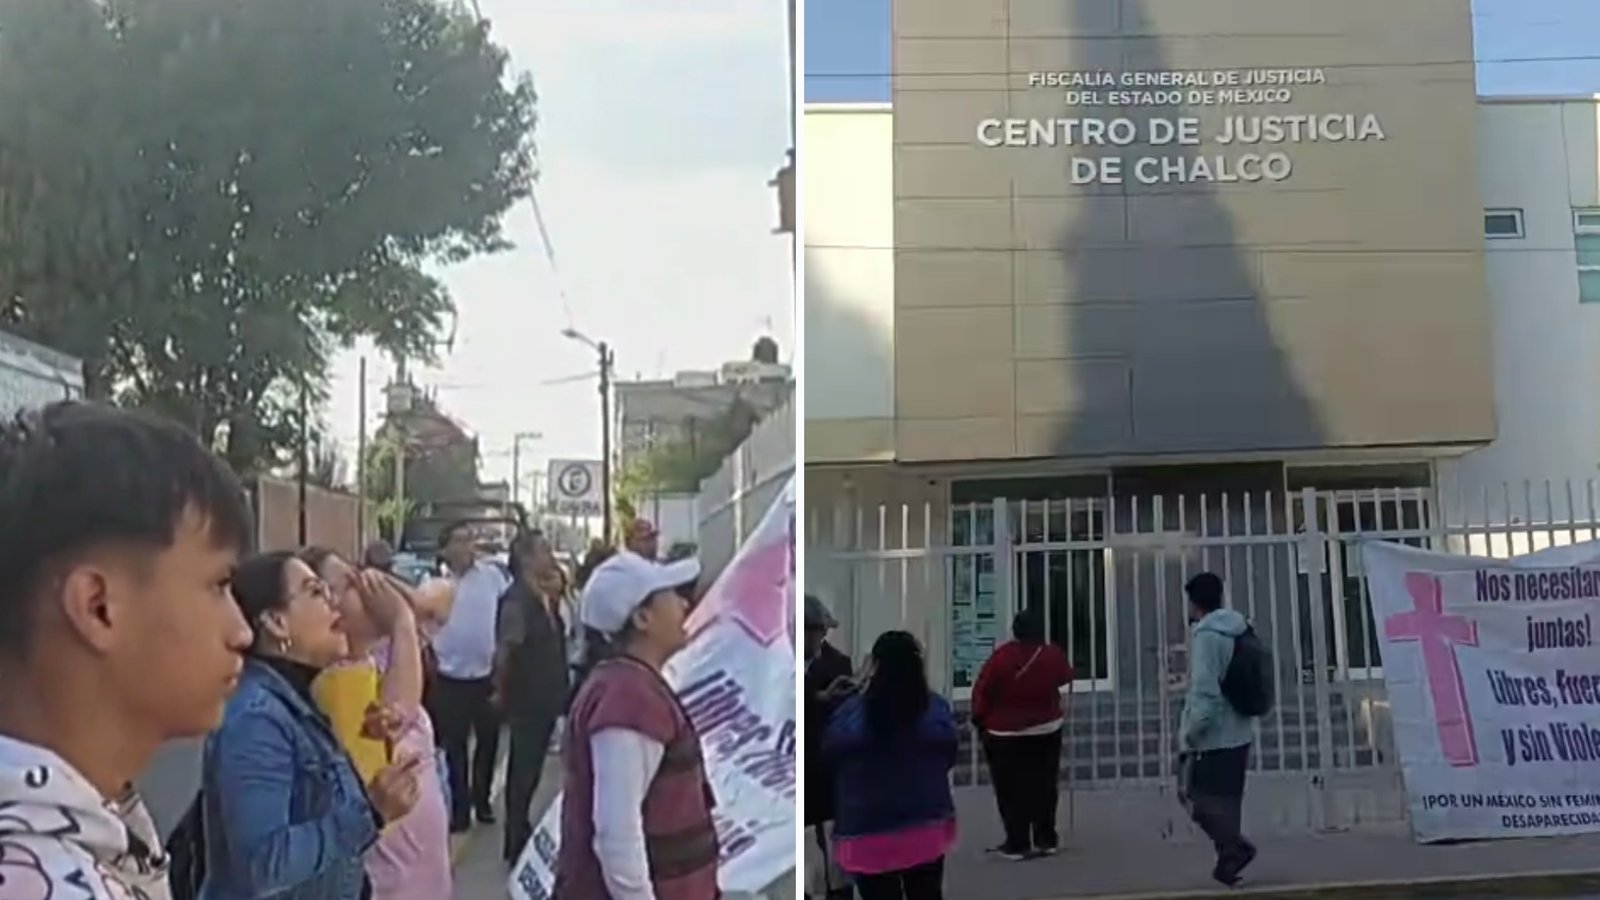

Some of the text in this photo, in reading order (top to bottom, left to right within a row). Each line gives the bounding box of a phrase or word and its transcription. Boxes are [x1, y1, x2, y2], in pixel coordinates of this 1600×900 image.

[1028, 68, 1326, 87] FISCALÍA GENERAL DE JUSTICIA
[1066, 90, 1104, 106] DEL
[1109, 90, 1182, 106] ESTADO
[1188, 89, 1214, 105] DE
[976, 114, 1386, 148] CENTRO DE JUSTICIA
[1070, 153, 1293, 185] DE CHALCO
[1476, 568, 1511, 602] Nos
[1526, 613, 1592, 653] juntas!
[1502, 729, 1516, 766] y
[1519, 725, 1555, 762] sin
[1461, 794, 1483, 808] UN
[1540, 795, 1561, 808] SIN
